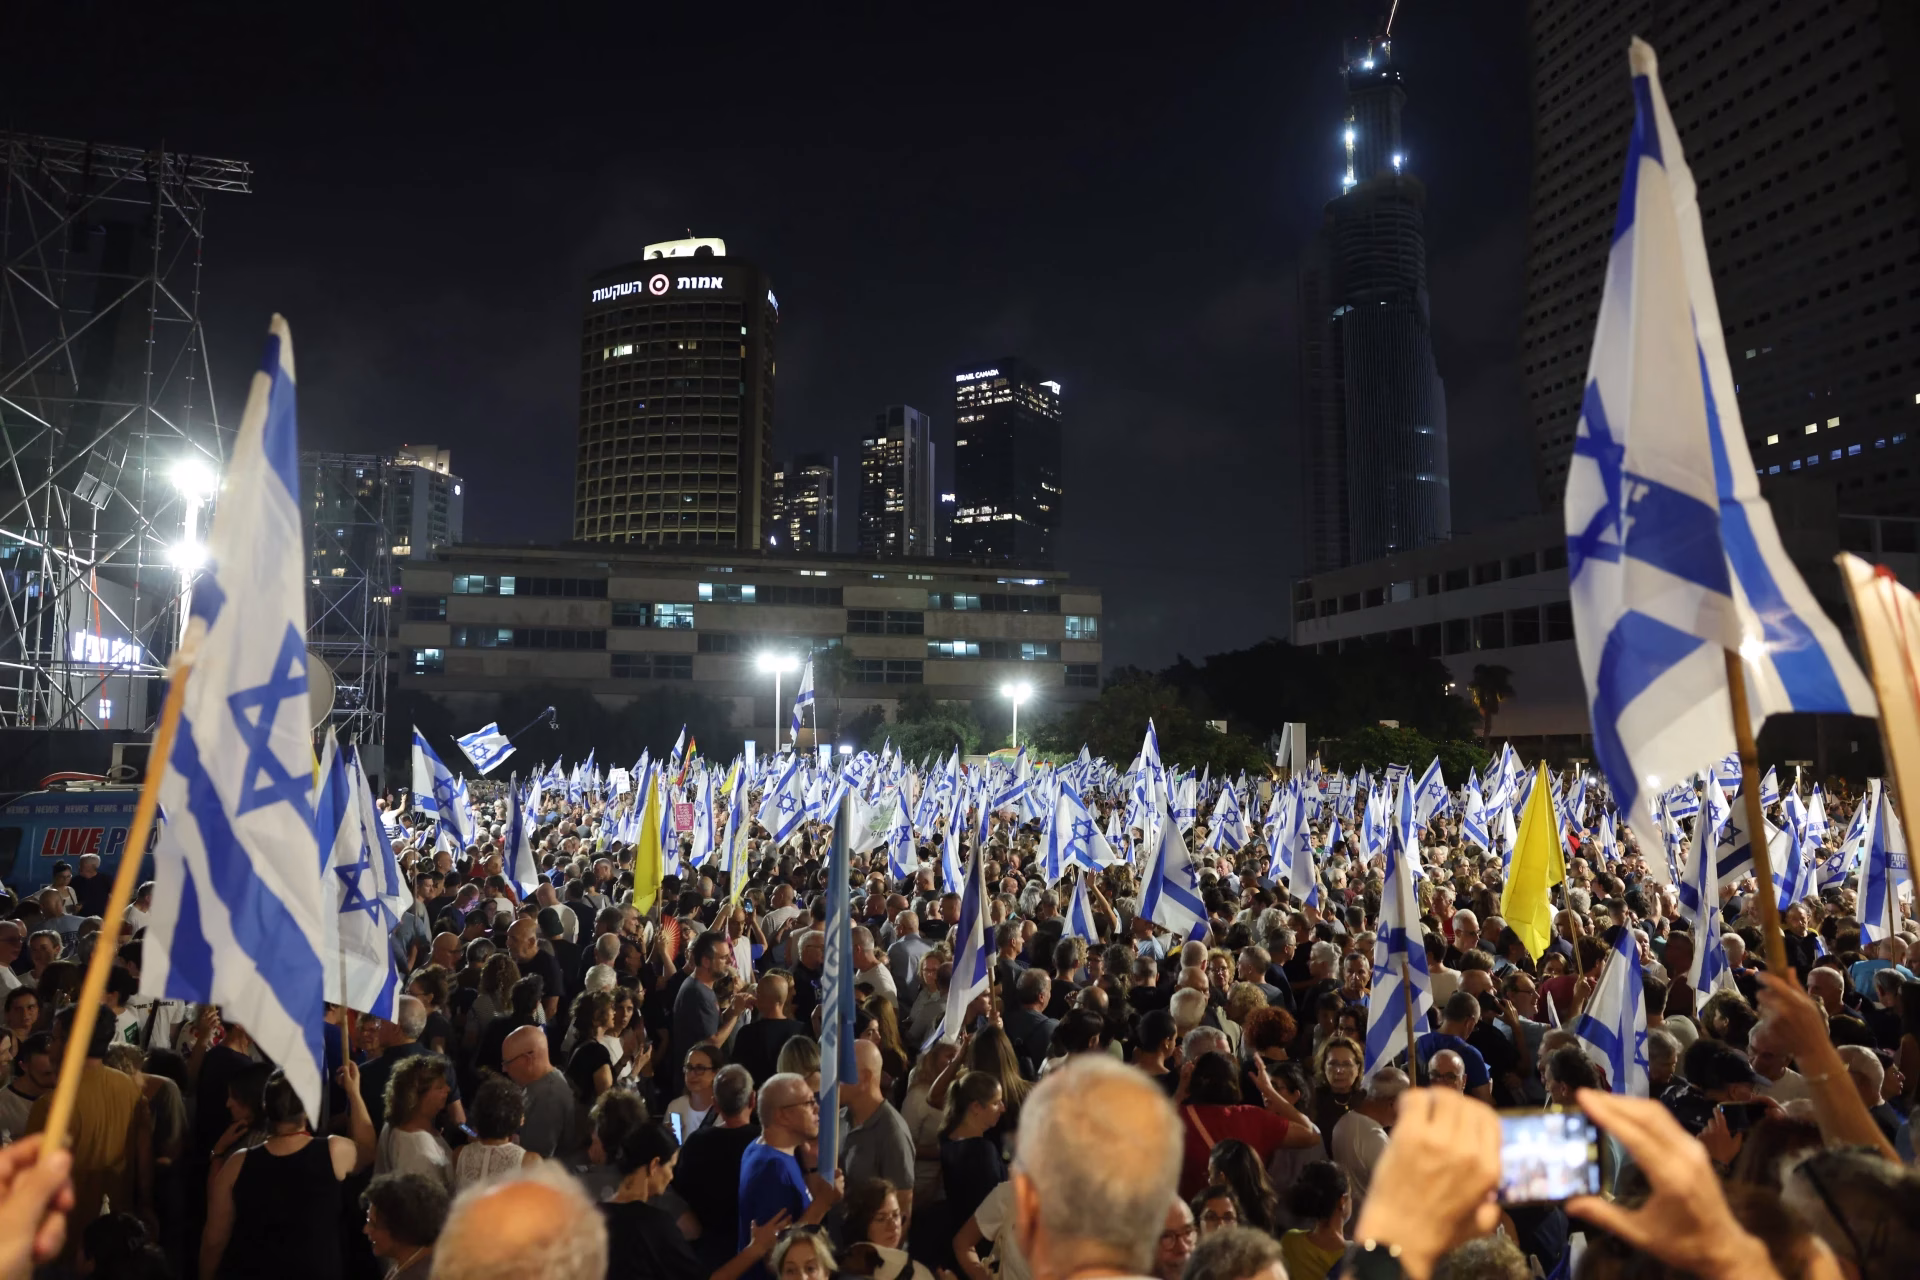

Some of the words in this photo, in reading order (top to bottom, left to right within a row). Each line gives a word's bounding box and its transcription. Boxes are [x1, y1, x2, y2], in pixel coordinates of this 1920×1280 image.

[592, 280, 642, 302] השקעות
[677, 276, 723, 290] אמות
[35, 805, 59, 814] NEWS
[64, 804, 89, 813] NEWS
[94, 804, 118, 813] NEWS
[40, 827, 105, 856] LIVE
